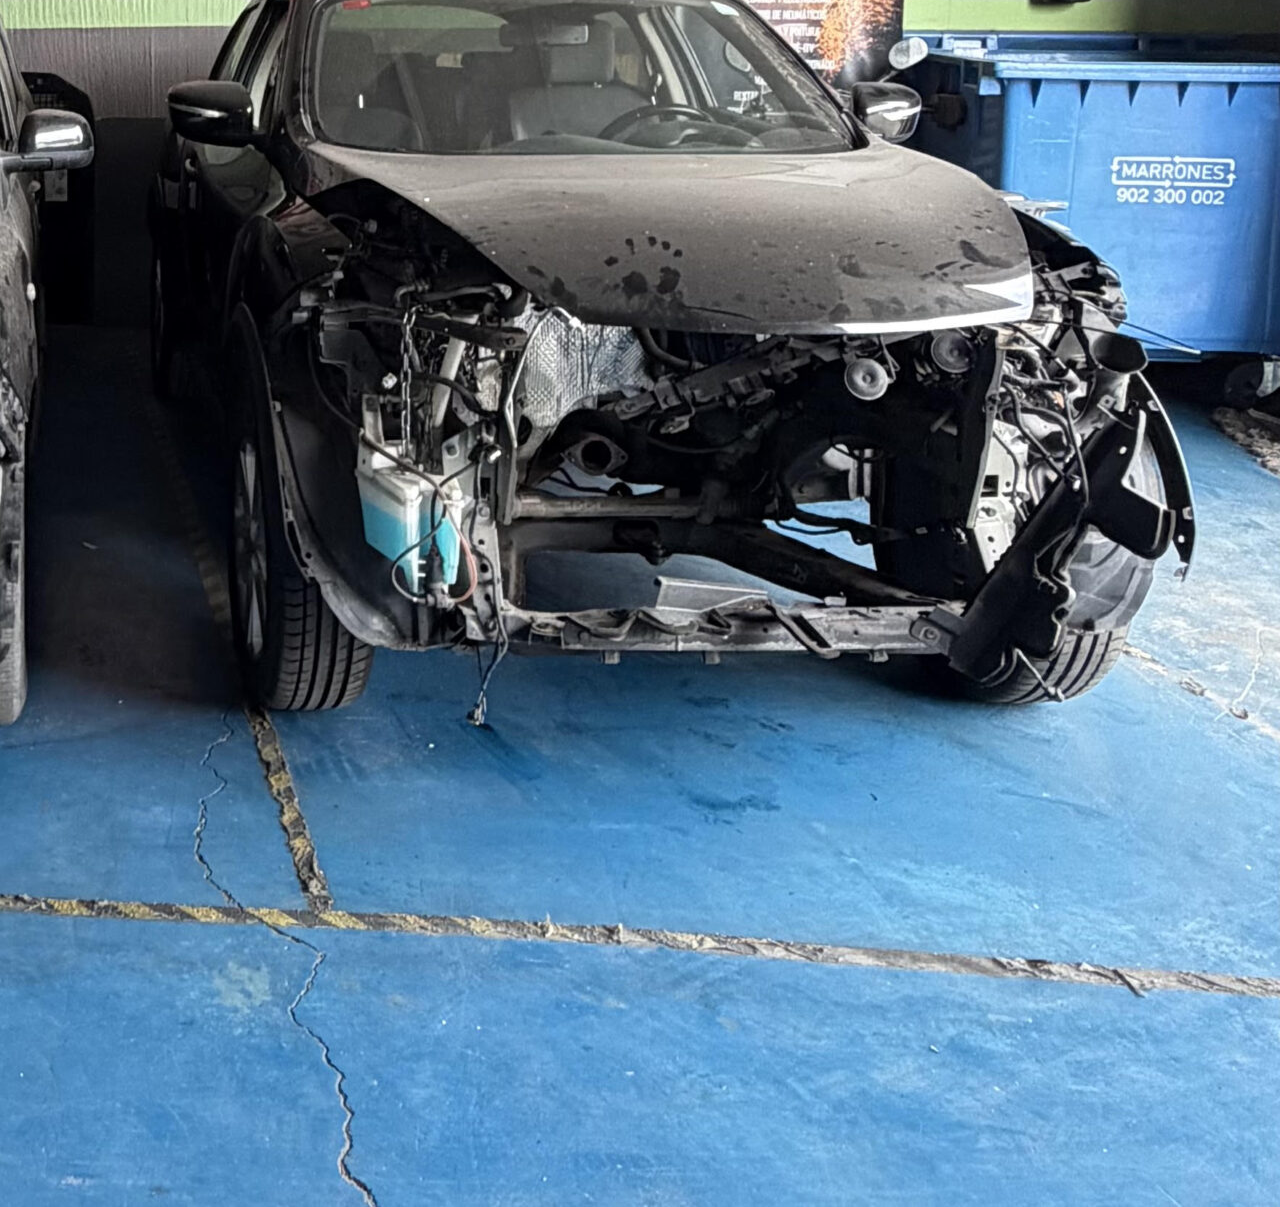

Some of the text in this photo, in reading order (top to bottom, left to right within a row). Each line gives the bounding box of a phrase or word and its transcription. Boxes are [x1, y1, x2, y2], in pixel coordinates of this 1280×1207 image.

[1121, 163, 1225, 180] MARRONES
[1116, 187, 1225, 205] 902 300 002
